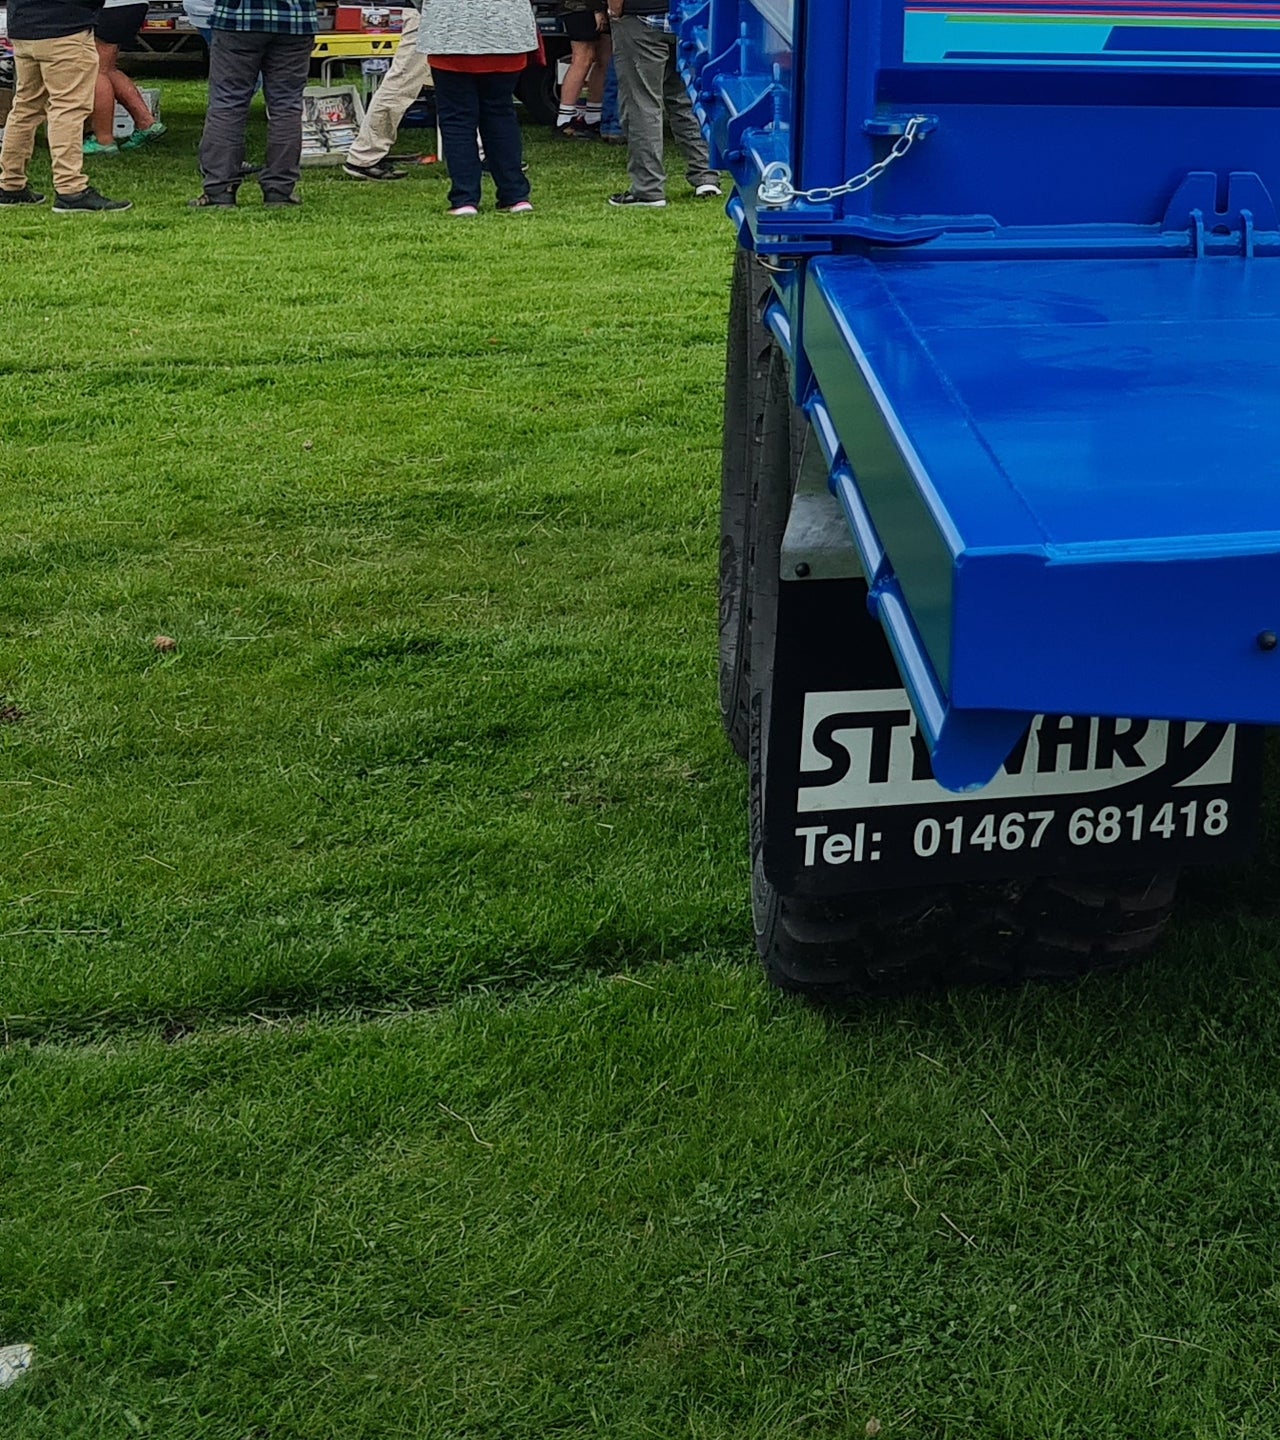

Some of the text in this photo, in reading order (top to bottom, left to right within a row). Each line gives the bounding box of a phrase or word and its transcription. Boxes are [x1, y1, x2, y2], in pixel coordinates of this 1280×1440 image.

[795, 798, 1229, 867] Tel: 01467 681418
